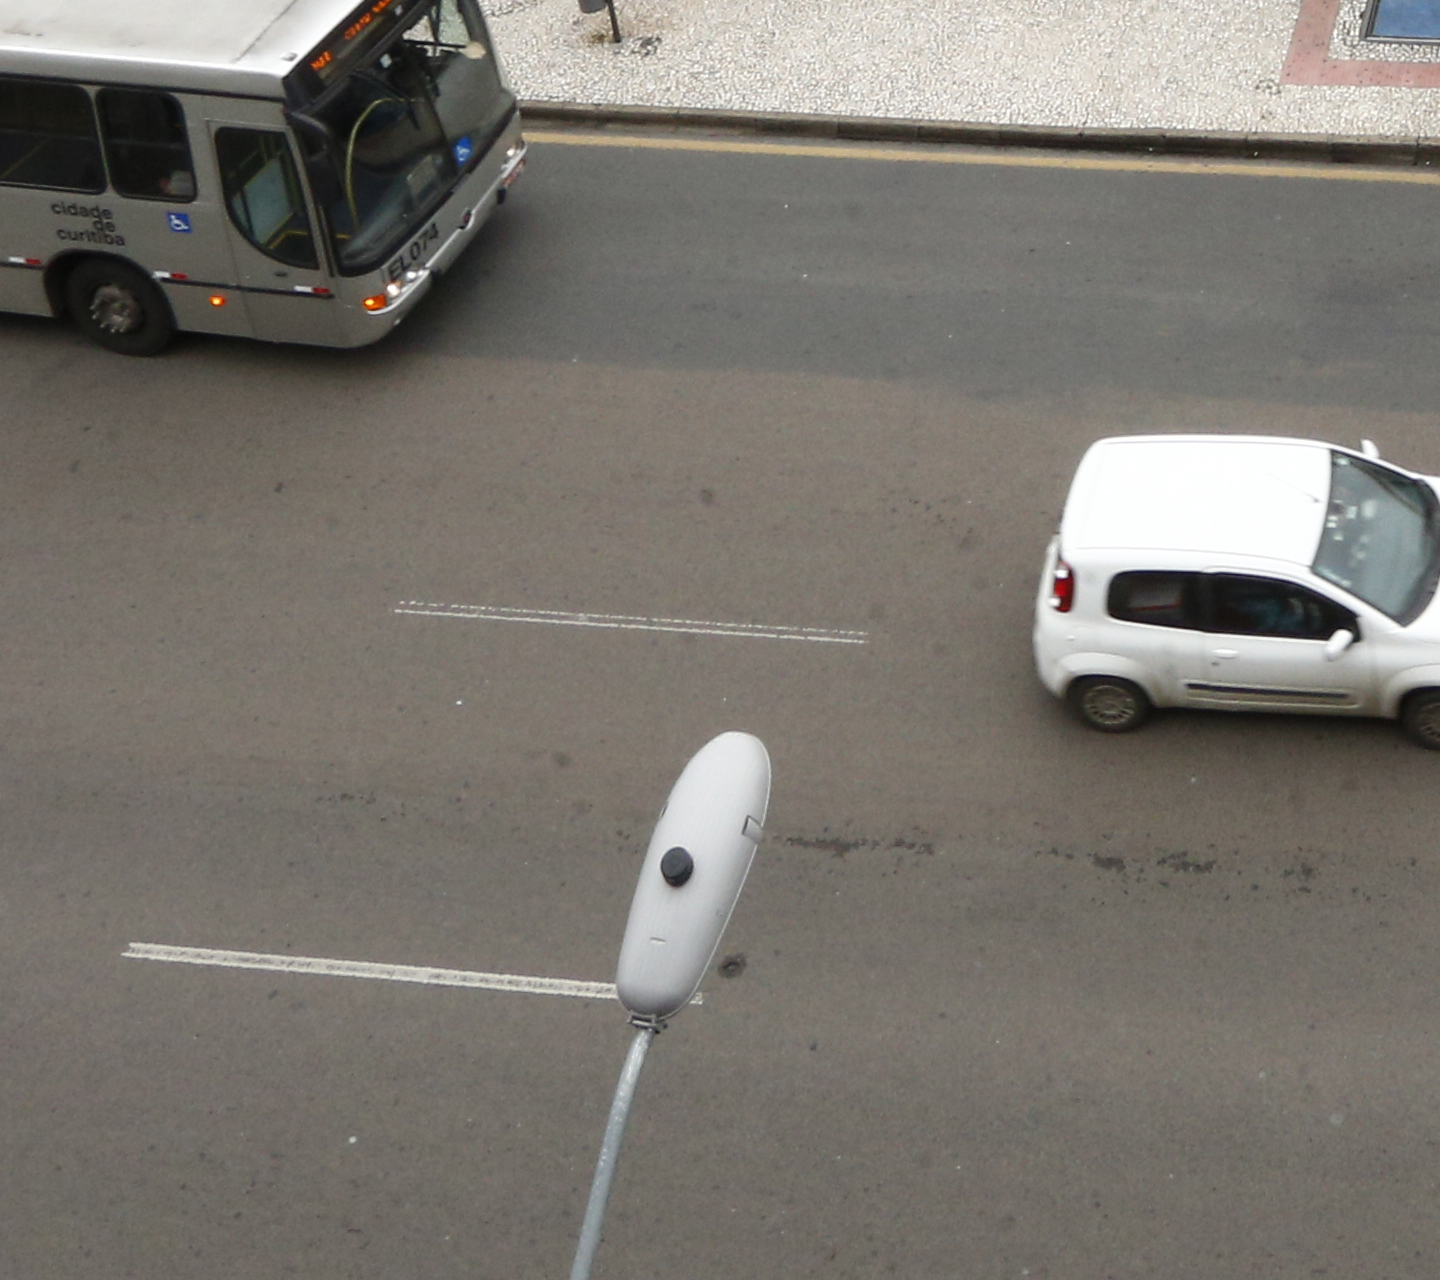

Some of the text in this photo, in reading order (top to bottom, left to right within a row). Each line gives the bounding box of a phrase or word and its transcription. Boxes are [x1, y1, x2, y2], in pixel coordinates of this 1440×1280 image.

[51, 202, 113, 220] cidade
[93, 217, 115, 232] de
[57, 229, 125, 246] curitiba
[388, 223, 438, 280] EL074
